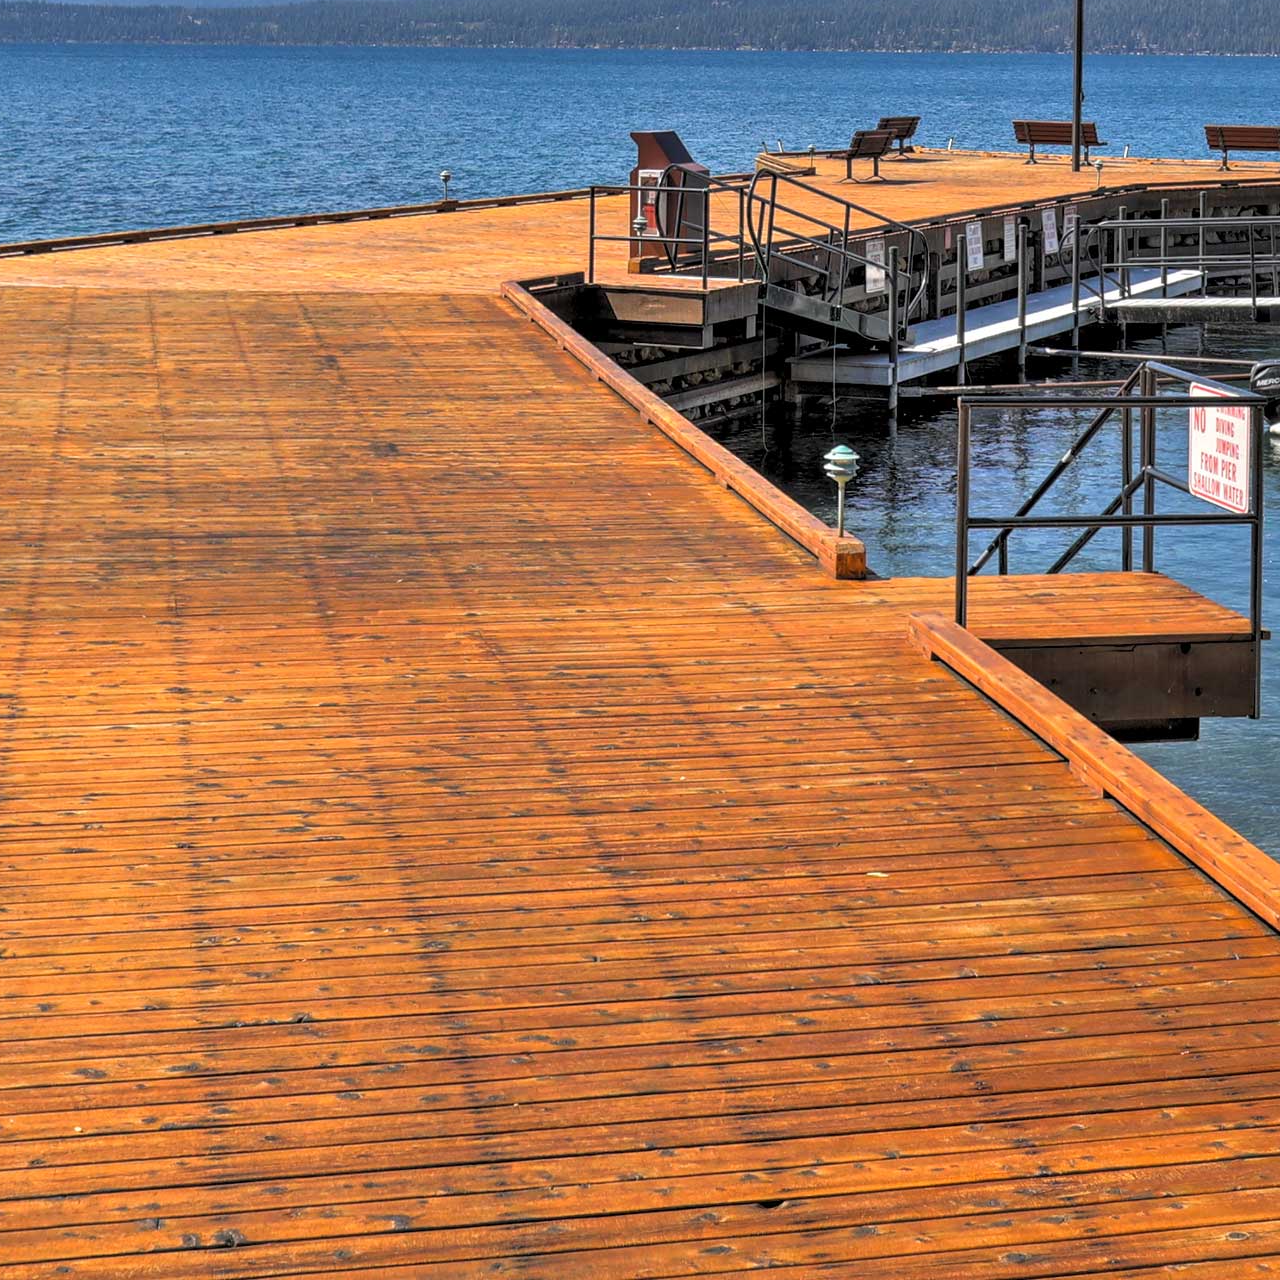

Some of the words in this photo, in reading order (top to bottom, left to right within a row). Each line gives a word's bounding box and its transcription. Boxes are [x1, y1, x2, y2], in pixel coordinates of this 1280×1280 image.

[1194, 407, 1206, 433] NO
[1216, 417, 1234, 438] DIVING
[1216, 437, 1239, 460] JUMPING
[1200, 451, 1219, 475] FROM
[1221, 459, 1237, 482] PIER
[1194, 471, 1221, 497] SHALLOW
[1223, 483, 1243, 506] WATER
